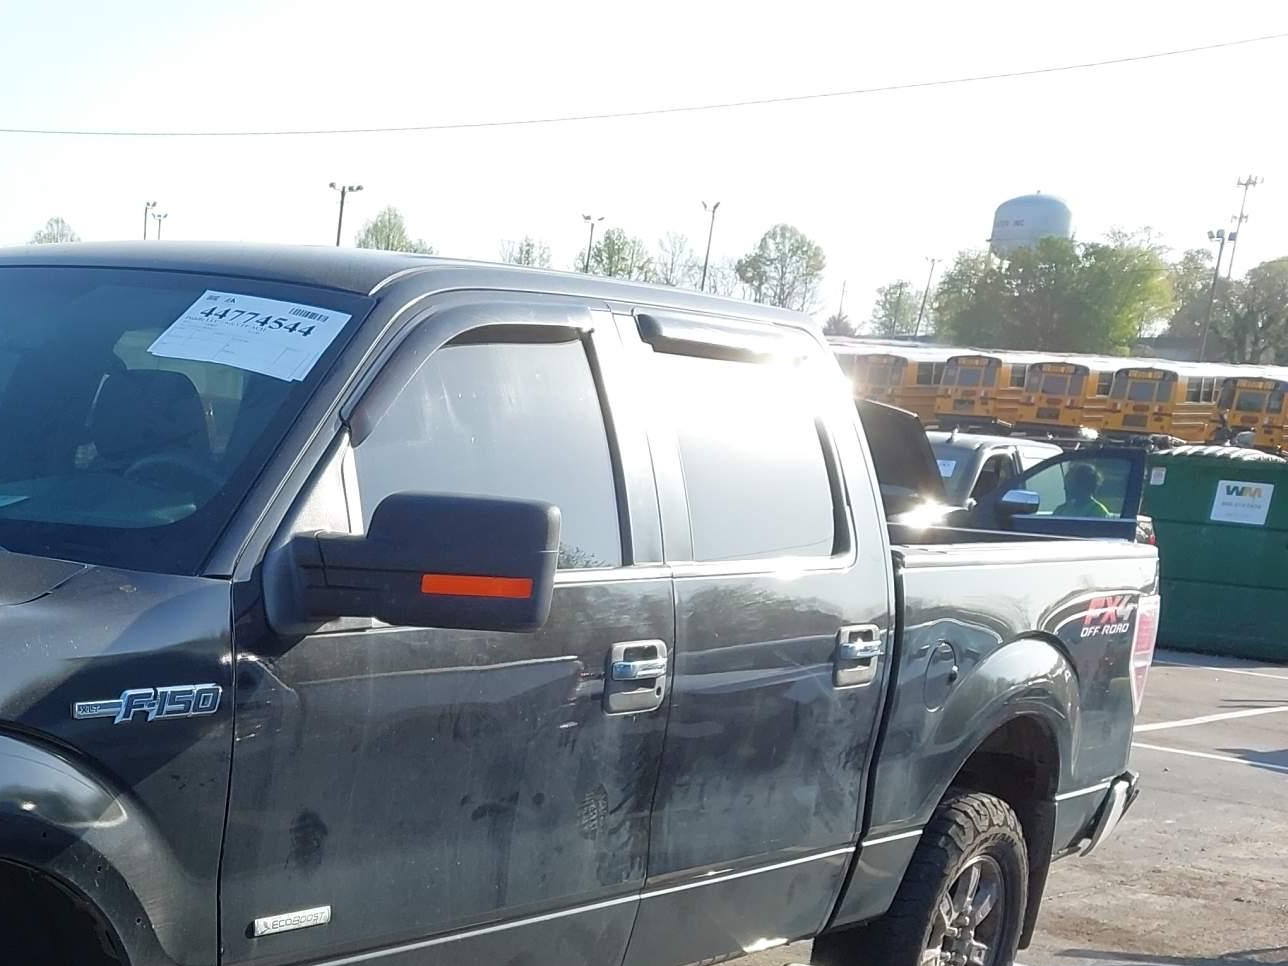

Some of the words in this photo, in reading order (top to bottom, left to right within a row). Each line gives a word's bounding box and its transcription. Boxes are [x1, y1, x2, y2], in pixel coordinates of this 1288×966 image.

[199, 305, 316, 337] 44774544
[1225, 485, 1262, 498] WM
[1083, 595, 1134, 625] FX4
[1080, 625, 1102, 638] OFF
[1102, 623, 1130, 636] ROAD
